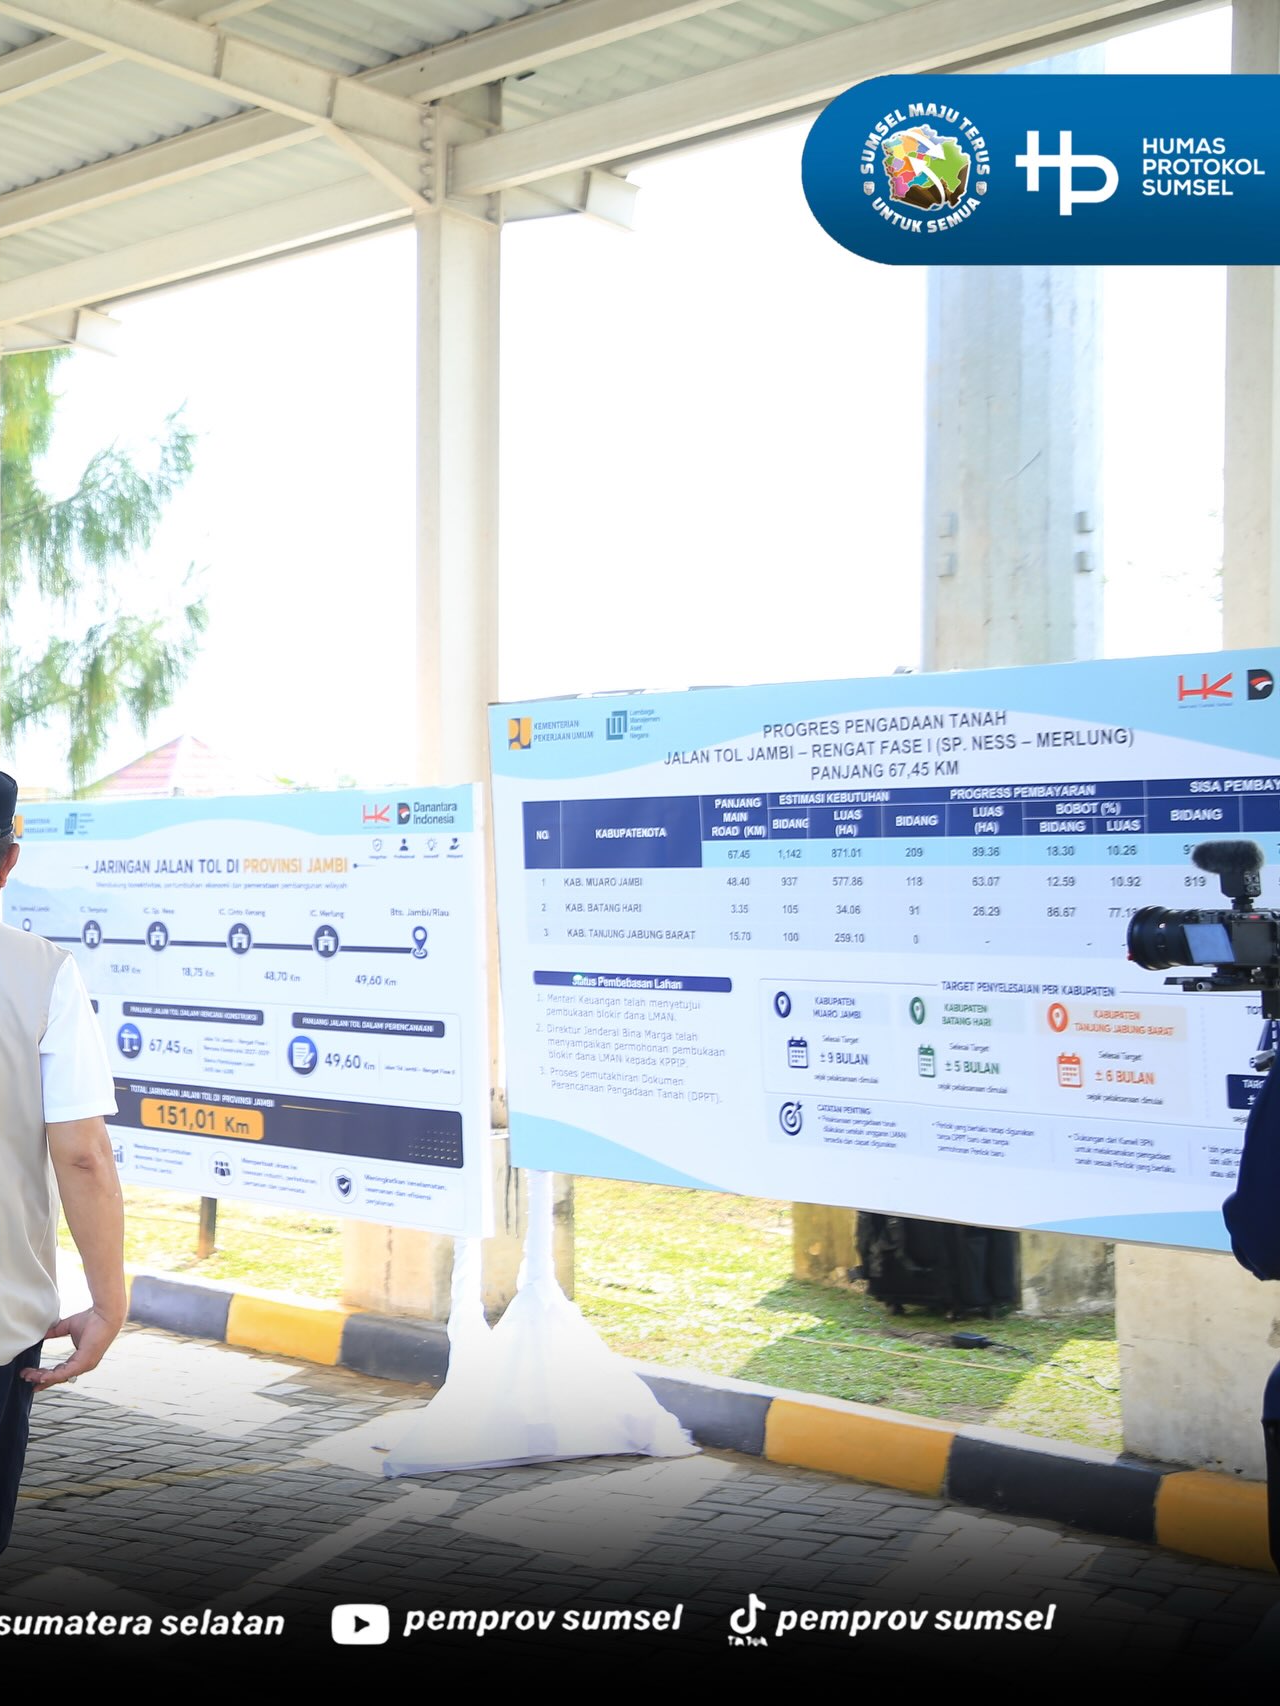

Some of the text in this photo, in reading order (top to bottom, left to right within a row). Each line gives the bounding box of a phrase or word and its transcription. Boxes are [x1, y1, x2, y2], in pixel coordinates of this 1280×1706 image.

[533, 720, 580, 731] KEMENTERIAN
[763, 711, 1007, 739] PROGRES PENGADAAN TANAH
[533, 730, 594, 742] PEKERJAAN UMUM
[663, 728, 1135, 765] JALAN TOL JAMBI RENGAT FASE (SP. NESS MERLUNG)
[811, 760, 959, 780] PANJANG 67,45 KM
[950, 785, 1096, 800] PROGRESS PEMBAYARAN
[1190, 781, 1221, 793] SISA
[714, 798, 762, 809] PANJANG
[779, 791, 889, 805] ESTIMASI KEBUTUHAN
[413, 802, 458, 813] Danantara
[972, 805, 1003, 818] LUAS
[1056, 803, 1098, 815] BOBOT
[413, 813, 455, 825] Indonesia
[722, 812, 748, 822] MAIN
[833, 810, 862, 821] LUAS
[1171, 808, 1222, 821] BIDANG
[772, 818, 809, 829] BIDANG
[896, 815, 938, 827] BIDANG
[1039, 821, 1085, 833] BIDANG
[1106, 820, 1141, 832] LUAS
[711, 826, 766, 838] ROAD (KM)
[835, 825, 858, 837] (HA)
[974, 821, 999, 835] (HA)
[728, 848, 923, 859] 67.45 1,142 871.01 209
[93, 857, 348, 874] JARINGAN JALAN TOL DI PROVINSI JAMBI
[586, 878, 617, 886] MUARO
[618, 878, 642, 886] JAMBI
[727, 878, 750, 886] 48.40
[781, 877, 797, 886] 937
[1111, 877, 1141, 887] 10.92
[1184, 877, 1206, 887] 819
[588, 904, 620, 912] BATANG
[622, 904, 642, 912] HARI
[731, 905, 748, 914] 3.35
[783, 905, 798, 914] 105
[589, 929, 624, 939] TANJUNG
[626, 930, 665, 940] JABUNG
[666, 930, 695, 940] BARAT
[729, 932, 751, 941] 15.70
[835, 934, 865, 943] 259.10
[598, 976, 682, 990] Pembebasan Lahan
[942, 981, 1115, 997] TARGET PENYELESAIAN PER KABUPATEN
[815, 997, 855, 1006] KABUPATEN
[944, 1003, 988, 1014] KABUPATEN
[942, 1016, 971, 1026] BATANG
[1093, 1010, 1140, 1020] KABUPATEN
[149, 1039, 180, 1053] 67,45
[325, 1053, 361, 1069] 49,60
[836, 1053, 869, 1066] BULAN
[964, 1061, 1000, 1075] BULAN
[1116, 1070, 1155, 1085] BULAN
[156, 1105, 249, 1134] 151,01 Km
